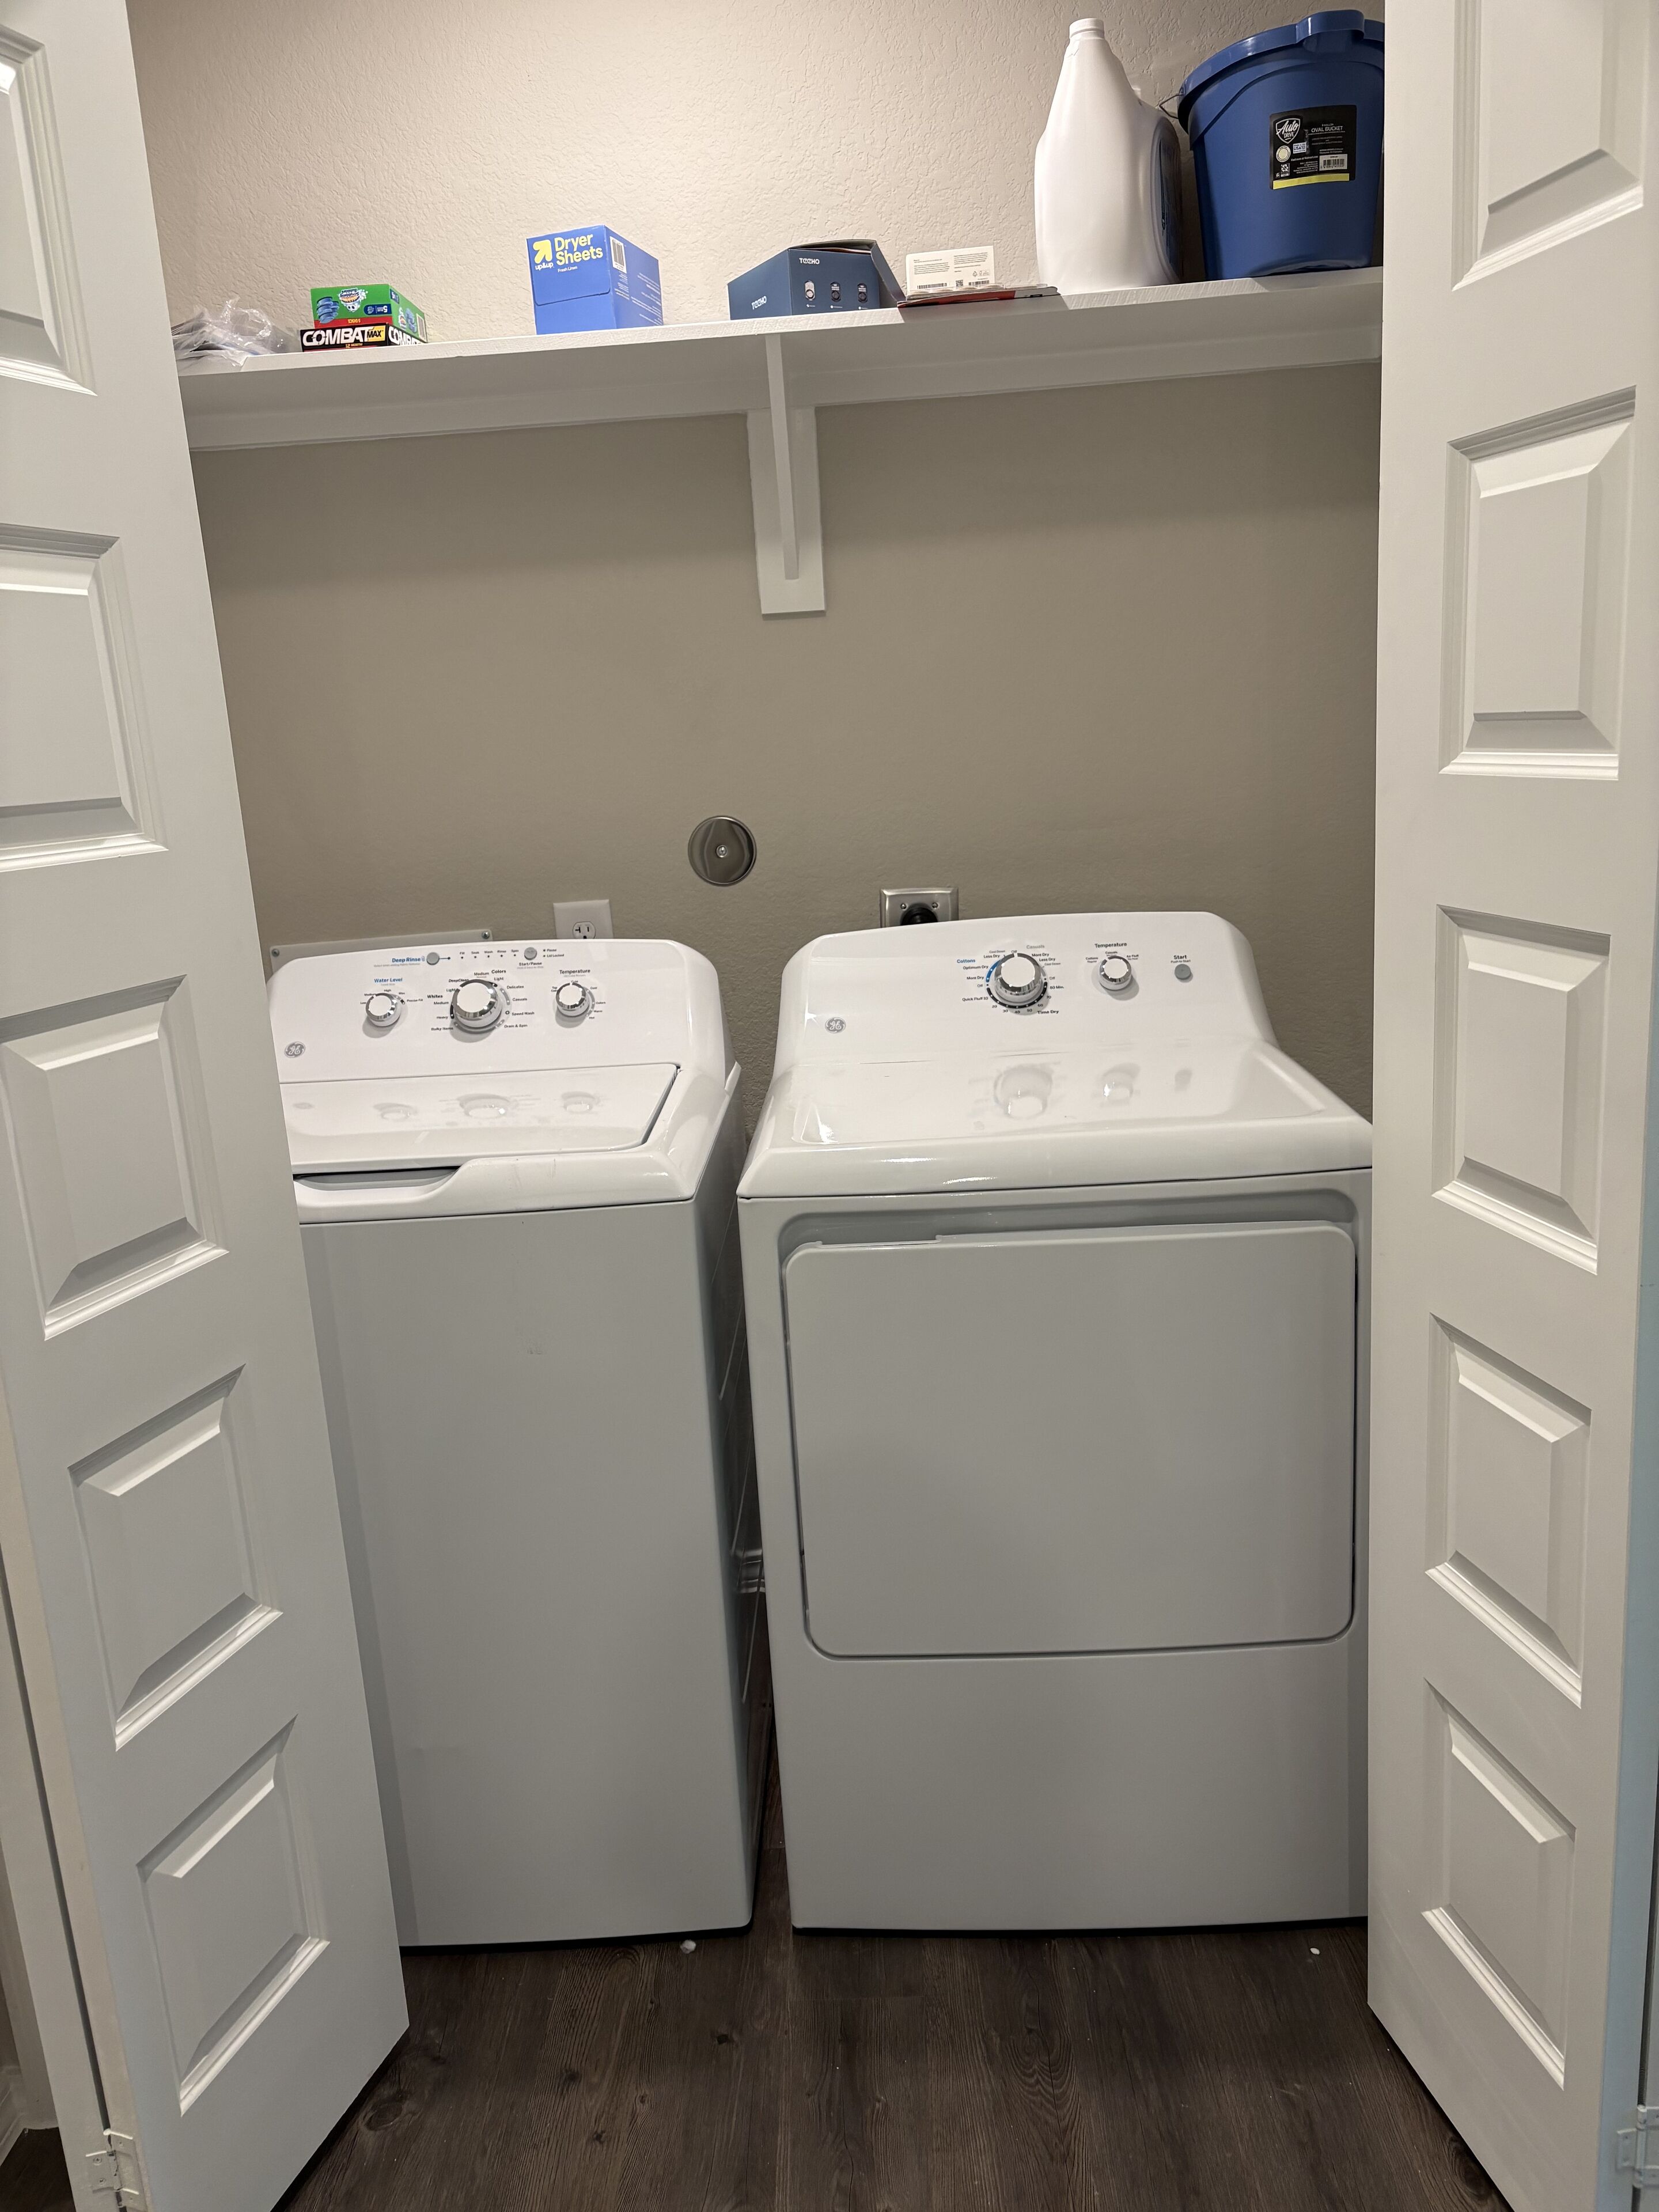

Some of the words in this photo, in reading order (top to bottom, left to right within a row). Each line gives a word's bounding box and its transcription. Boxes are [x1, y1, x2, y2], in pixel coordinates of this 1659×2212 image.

[1276, 120, 1299, 135] Auto
[554, 234, 593, 251] Dryer
[555, 246, 604, 266] Sheets
[535, 262, 554, 271] up&up
[302, 327, 373, 346] COMBAT
[366, 329, 381, 338] MAX
